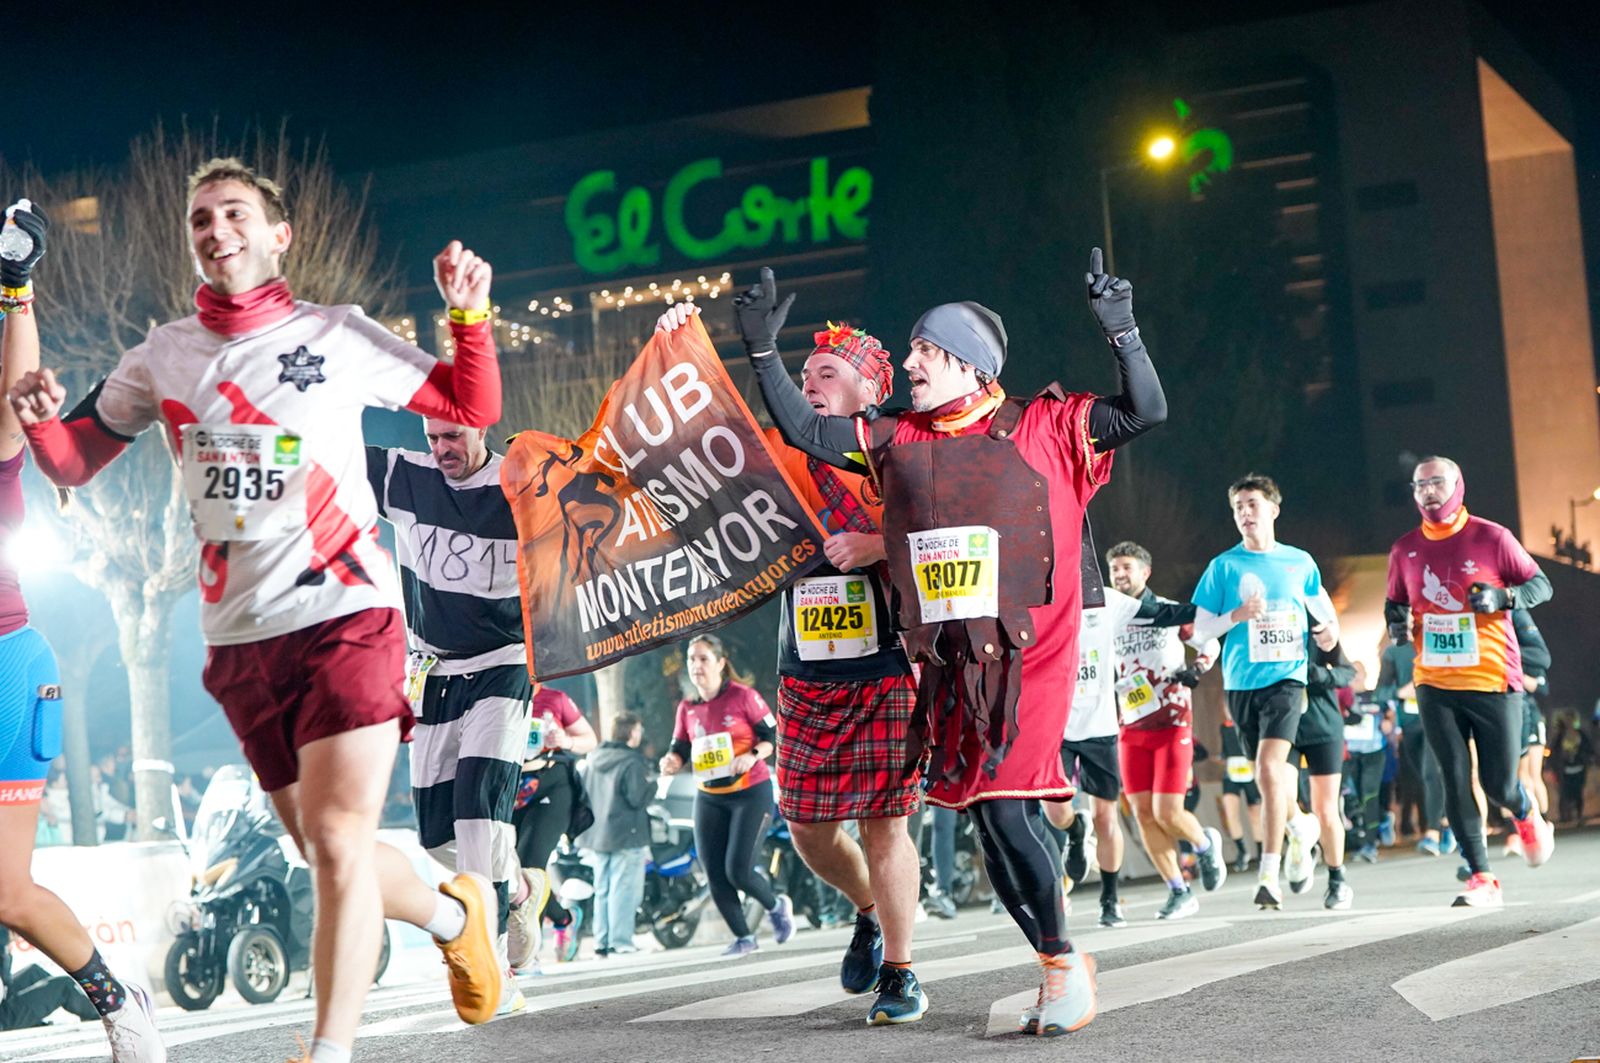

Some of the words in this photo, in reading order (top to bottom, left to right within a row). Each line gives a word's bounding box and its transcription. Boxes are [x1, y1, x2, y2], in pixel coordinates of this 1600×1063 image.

[565, 170, 659, 273] El
[663, 156, 873, 259] Corte
[594, 362, 713, 477] CLUB
[211, 437, 246, 449] NOCHE
[197, 451, 219, 462] SAN
[204, 466, 284, 501] 2935
[924, 539, 947, 550] NOCHE
[949, 539, 959, 547] DE
[919, 554, 931, 562] SAN
[923, 561, 981, 590] 13077
[808, 586, 828, 594] NOCHE
[829, 585, 838, 593] DE
[801, 597, 814, 605] SAN
[801, 606, 863, 631] 12425
[1260, 630, 1294, 644] 3539
[1432, 633, 1463, 648] 7941
